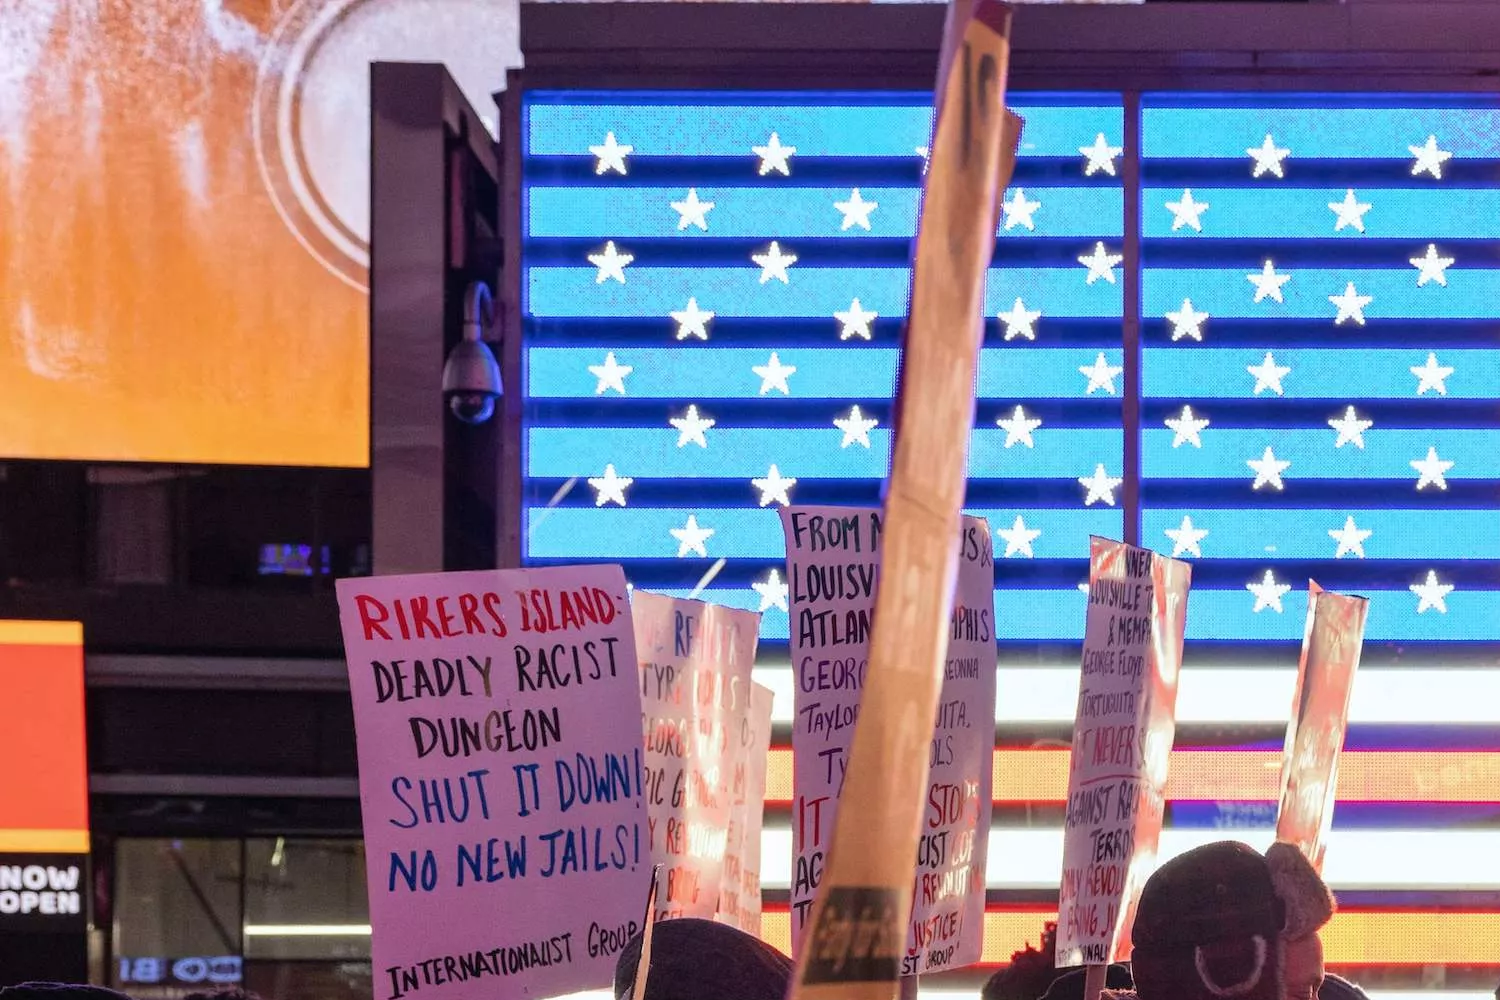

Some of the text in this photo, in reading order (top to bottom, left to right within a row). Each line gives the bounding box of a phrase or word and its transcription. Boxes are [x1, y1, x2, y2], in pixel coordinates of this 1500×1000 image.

[792, 513, 860, 552] FROM
[794, 563, 880, 604] LOUISV
[1090, 580, 1141, 611] LOUISVILLE
[354, 586, 623, 641] RIKERS ISLAND:
[799, 608, 874, 648] ATLAN
[371, 637, 619, 703] DEADLY RACIST
[800, 656, 868, 693] GEOR
[1083, 649, 1144, 685] GEORGE FLOYD
[410, 707, 560, 758] DUNGEON
[1093, 726, 1133, 768] NEVER
[389, 768, 491, 828] SHUT
[513, 763, 541, 817] IT
[554, 748, 642, 812] DOWN!
[1066, 784, 1115, 829] AGAINST
[799, 795, 831, 852] IT
[0, 864, 80, 891] NOW
[388, 850, 437, 892] NO
[456, 835, 527, 887] NEW
[539, 824, 640, 878] JAILS!
[0, 891, 81, 915] OPEN
[386, 921, 637, 999] INTERNATIONALIST GROUP
